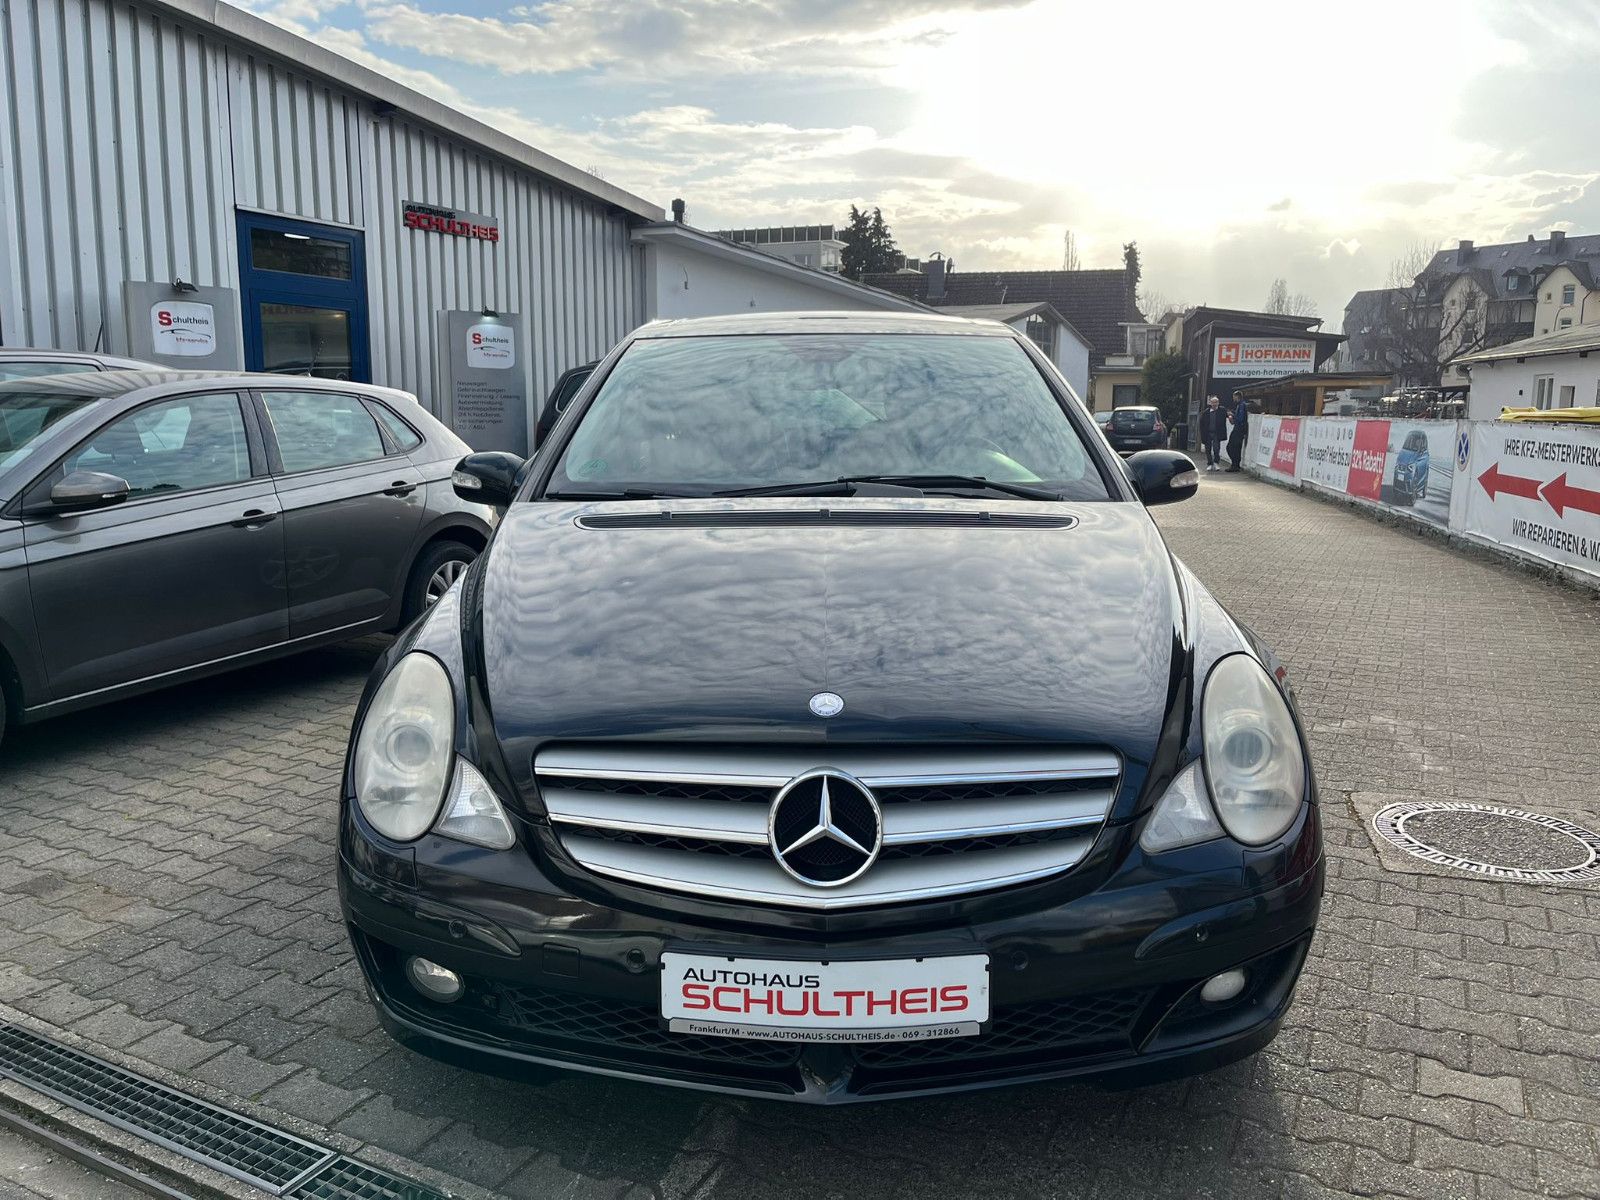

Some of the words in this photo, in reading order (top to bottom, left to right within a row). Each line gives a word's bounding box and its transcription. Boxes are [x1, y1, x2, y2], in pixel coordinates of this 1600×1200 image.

[405, 204, 455, 219] AUTOHAUS
[405, 211, 498, 241] SCHULTHEIS
[158, 311, 209, 326] Schultheis
[472, 333, 509, 345] Schultheis
[1244, 349, 1311, 359] HOFMANN
[1504, 438, 1520, 457] IHRE
[1512, 518, 1527, 539] WIR
[1528, 523, 1579, 555] REPARIEREN
[1580, 537, 1588, 558] &
[683, 967, 820, 989] AUTOHAUS
[681, 983, 969, 1017] SCHULTHEIS
[689, 1024, 740, 1036] Frankfurt/M
[747, 1030, 895, 1041] www.AUTOHAUS-SCHULTHEIS.de
[902, 1031, 919, 1040] 069
[926, 1027, 960, 1038] 312866
